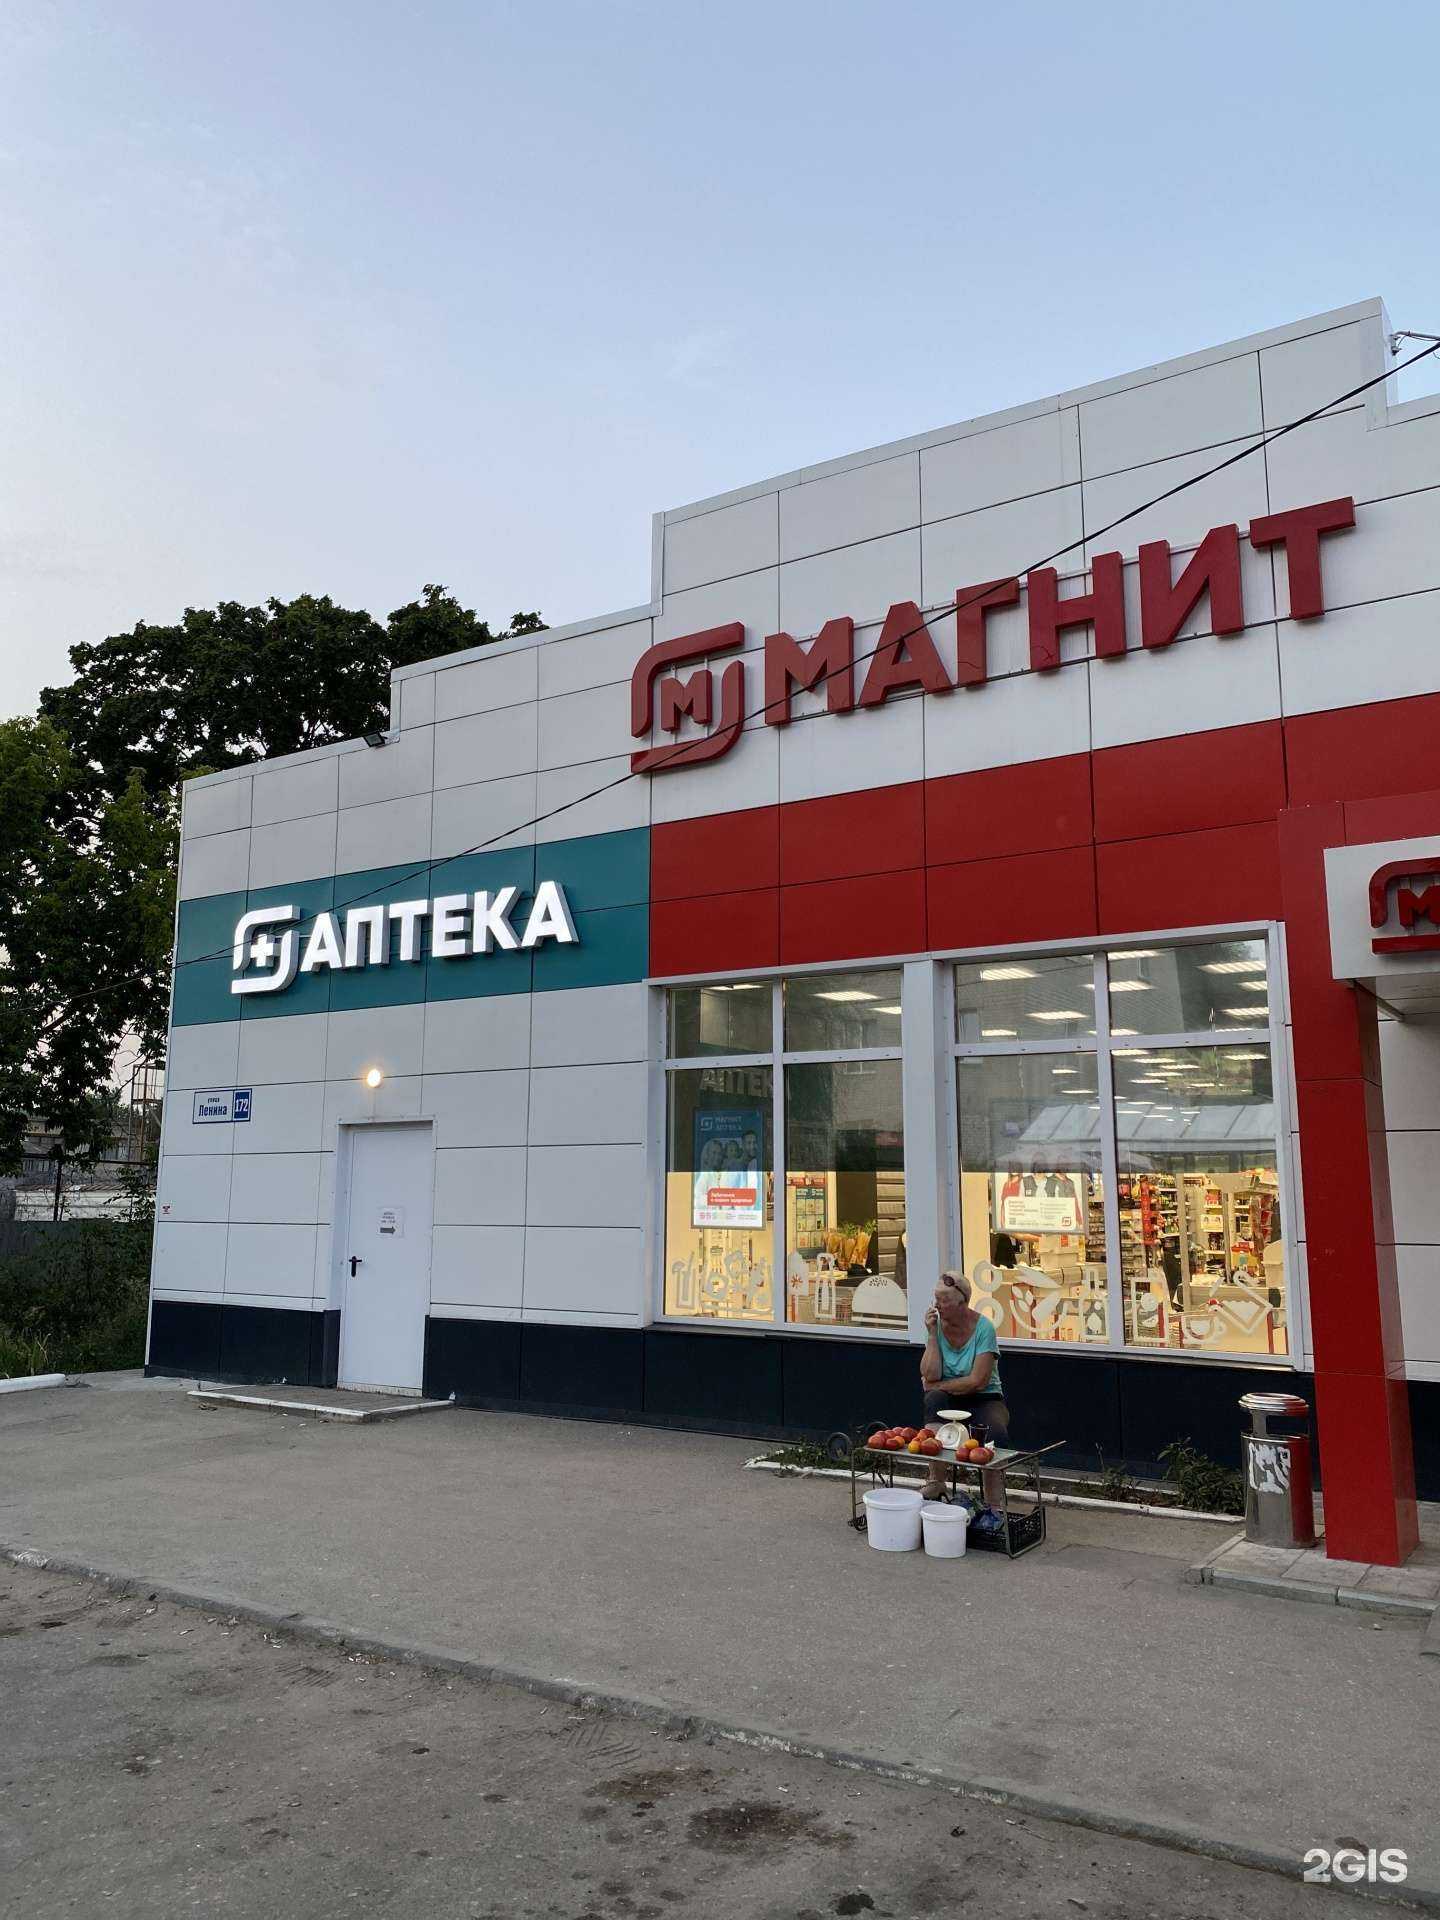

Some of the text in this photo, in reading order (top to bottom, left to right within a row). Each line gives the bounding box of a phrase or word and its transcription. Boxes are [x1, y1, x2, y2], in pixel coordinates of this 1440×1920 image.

[764, 496, 1356, 726] МАГНИТ
[300, 880, 579, 973] АПТЕКА
[198, 1104, 228, 1117] Ленина
[235, 1098, 249, 1112] 172
